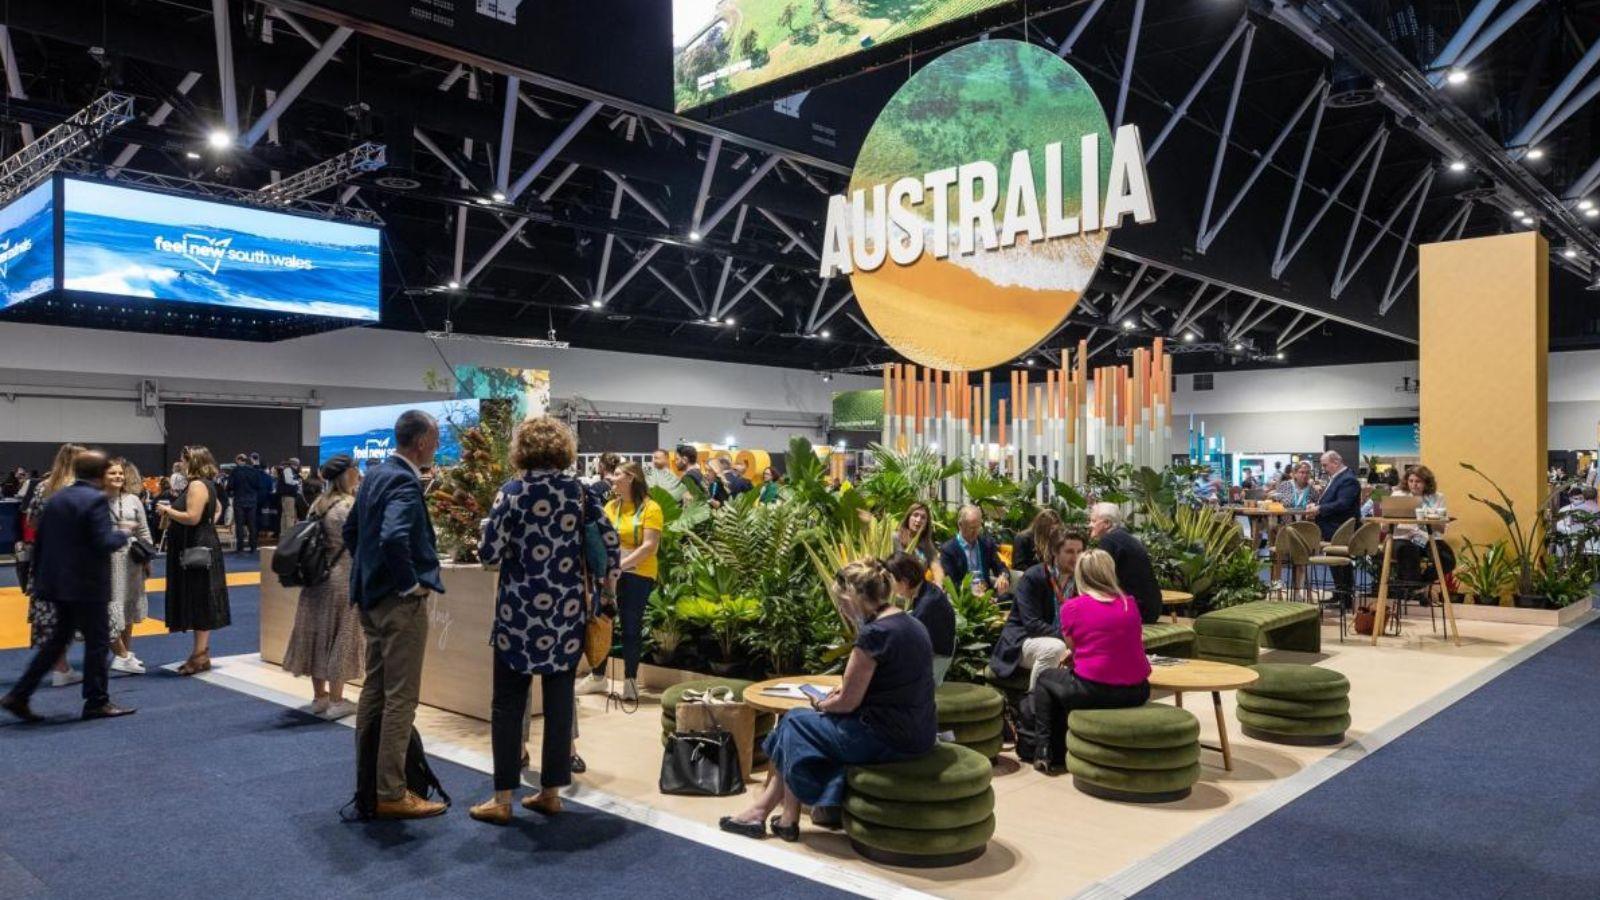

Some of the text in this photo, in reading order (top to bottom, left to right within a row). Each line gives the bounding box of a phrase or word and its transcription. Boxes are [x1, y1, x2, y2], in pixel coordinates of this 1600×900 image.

[820, 123, 1156, 279] AUSTRALIA
[154, 234, 314, 270] feel new south wales
